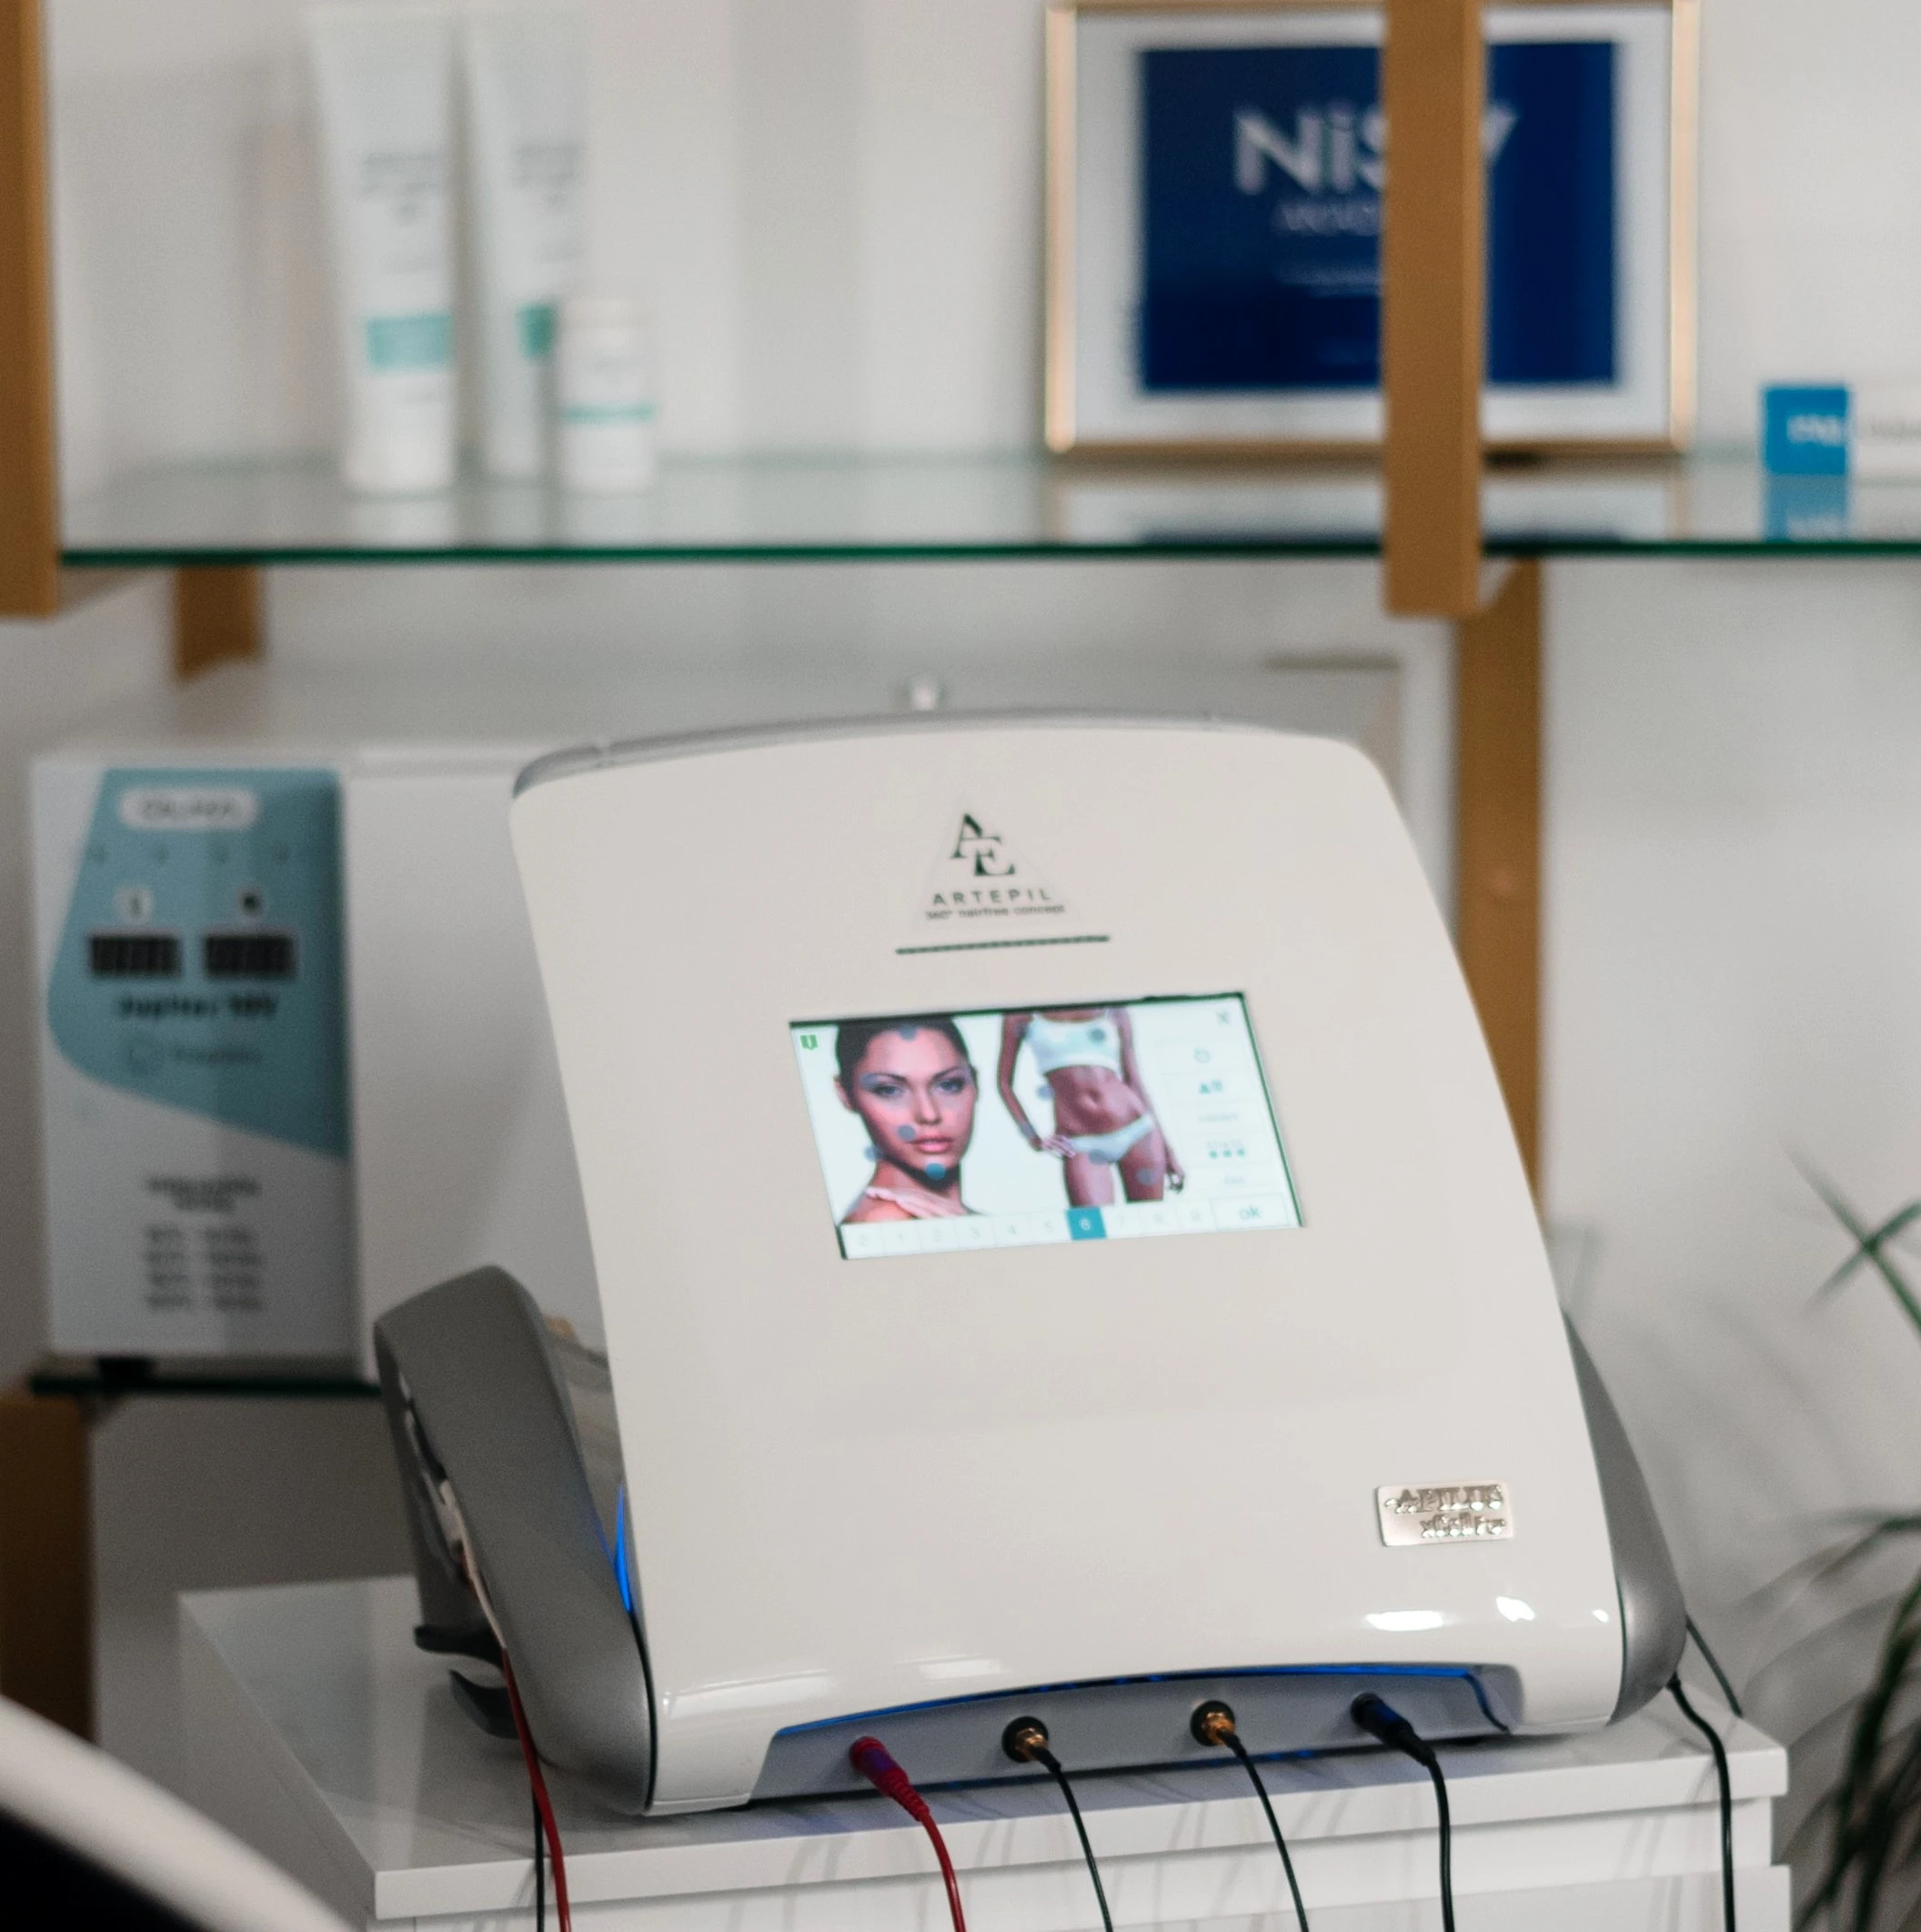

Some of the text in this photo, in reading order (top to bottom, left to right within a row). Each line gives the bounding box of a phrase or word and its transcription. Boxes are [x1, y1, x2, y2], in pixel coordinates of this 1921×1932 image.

[932, 888, 1051, 907] ARTEPIL
[959, 906, 1009, 919] hairfree
[1013, 904, 1065, 916] concept
[968, 1224, 981, 1240] 3
[1007, 1223, 1017, 1236] 4
[1079, 1217, 1091, 1232] 6
[1238, 1204, 1262, 1221] ok
